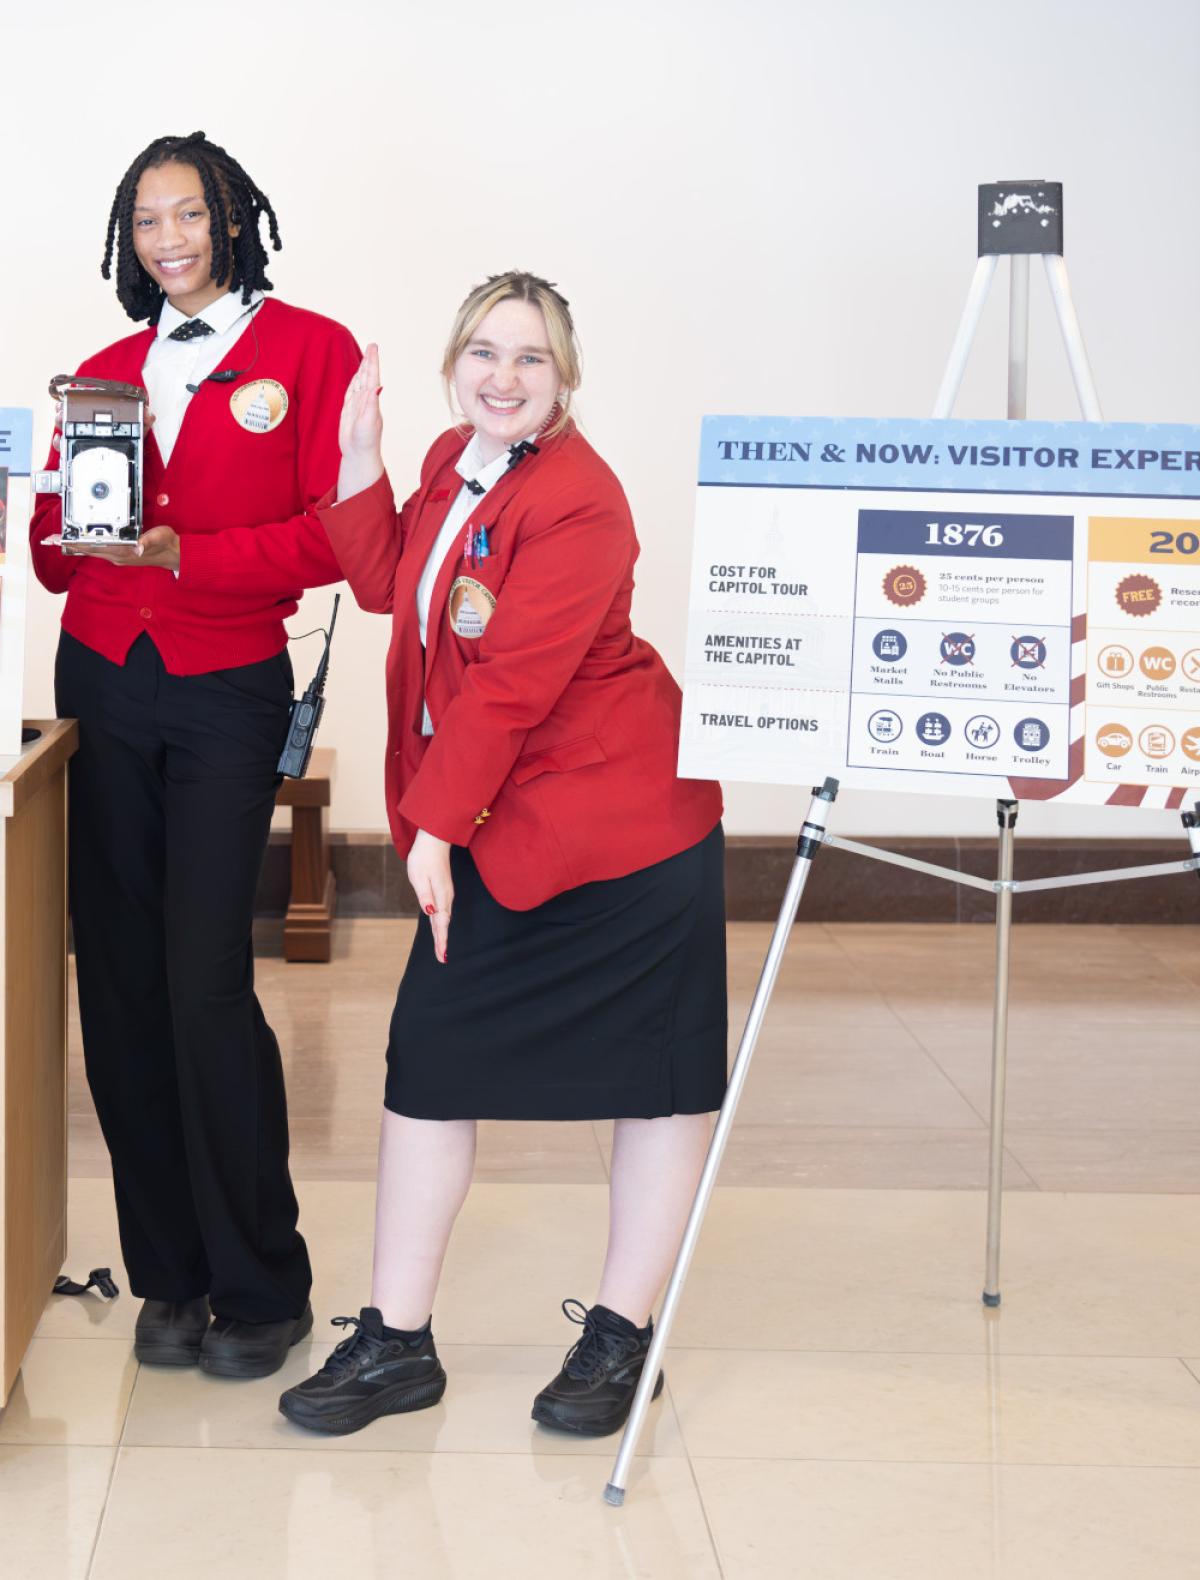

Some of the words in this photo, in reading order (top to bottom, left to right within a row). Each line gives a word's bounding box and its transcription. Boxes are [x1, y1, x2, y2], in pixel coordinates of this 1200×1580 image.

[718, 440, 813, 464] THEN
[820, 443, 846, 463] &
[856, 444, 940, 466] NOW:
[948, 445, 1079, 468] VISITOR
[1092, 448, 1200, 472] EXPER
[924, 523, 1004, 548] 1876
[1150, 532, 1200, 554] 20
[710, 564, 745, 578] COST
[749, 566, 776, 579] FOR
[986, 576, 1003, 584] per
[1006, 576, 1044, 585] person
[709, 581, 767, 595] CAPITOL
[771, 583, 808, 596] TOUR
[962, 585, 984, 593] cents
[986, 587, 999, 595] per
[1002, 588, 1030, 596] person
[1122, 589, 1155, 603] FREE
[705, 635, 782, 650] AMENITIES
[785, 638, 802, 650] AT
[705, 650, 732, 664] THE
[736, 652, 795, 667] CAPITOL
[1144, 657, 1172, 671] WC
[870, 666, 907, 674] Market
[934, 669, 947, 677] No
[950, 670, 984, 678] Public
[873, 677, 903, 685] Stalls
[930, 680, 987, 690] Restrooms
[1004, 684, 1055, 693] Elevators
[700, 713, 753, 728] TRAVEL
[757, 716, 818, 732] OPTIONS
[870, 747, 899, 756] Train
[920, 750, 944, 758] Boat
[966, 753, 998, 762] Horse
[1012, 756, 1050, 766] Trolley
[1106, 762, 1122, 770] Car
[1146, 764, 1168, 773] Train
